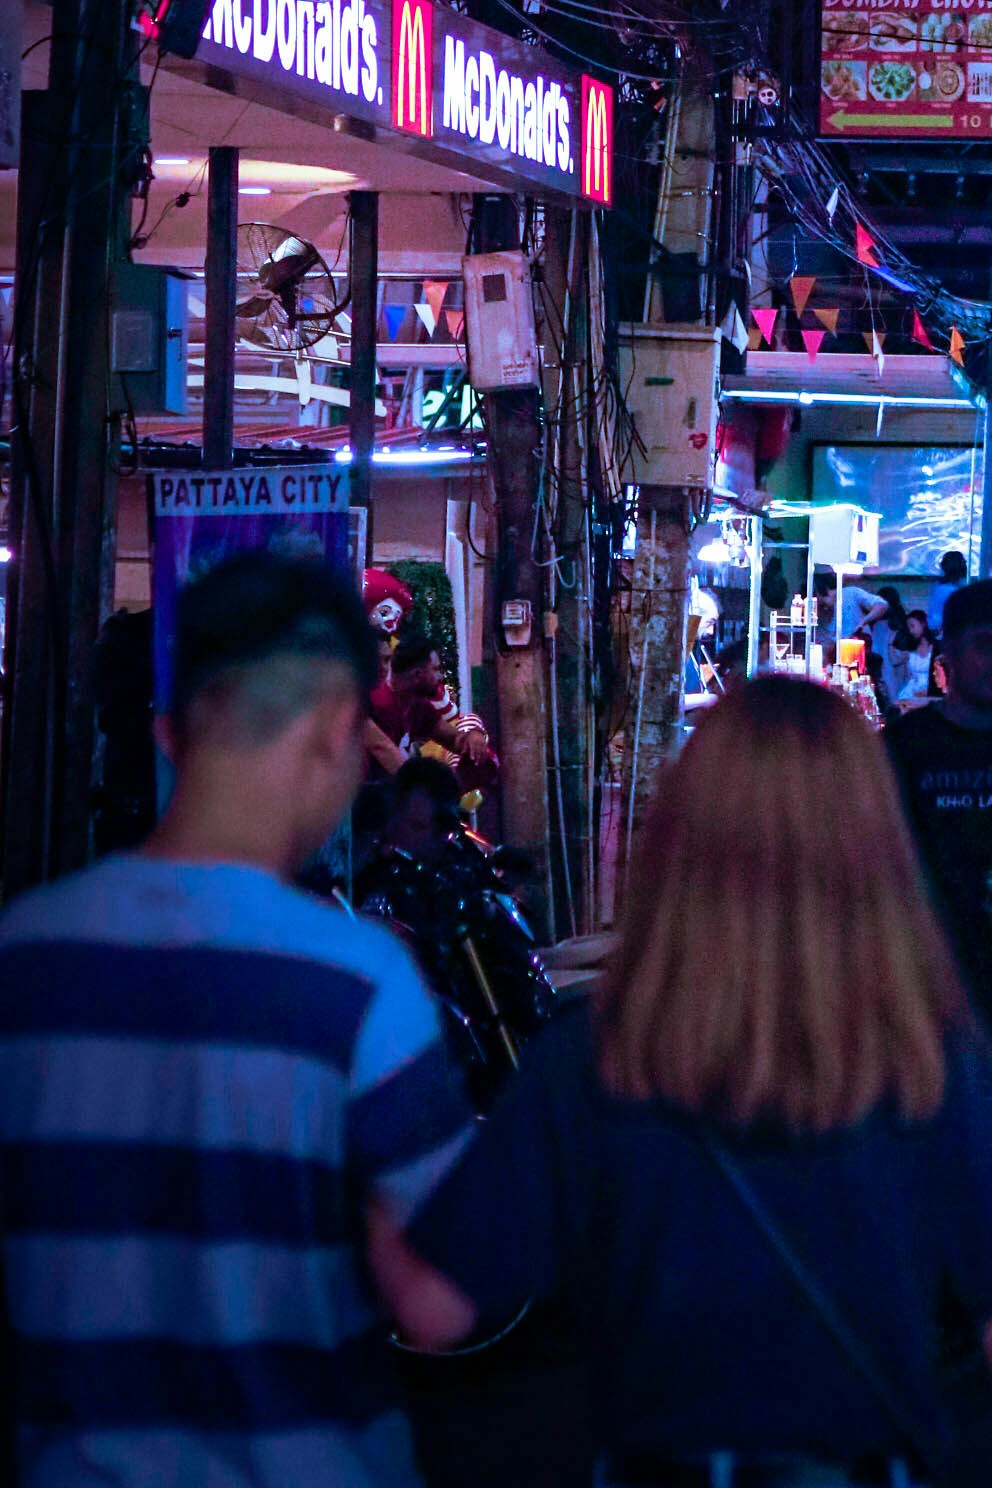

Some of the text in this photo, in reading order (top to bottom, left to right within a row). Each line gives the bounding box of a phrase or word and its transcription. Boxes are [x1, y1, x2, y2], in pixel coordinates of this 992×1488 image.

[959, 115, 982, 129] 10
[160, 474, 342, 507] PATTAYA CITY
